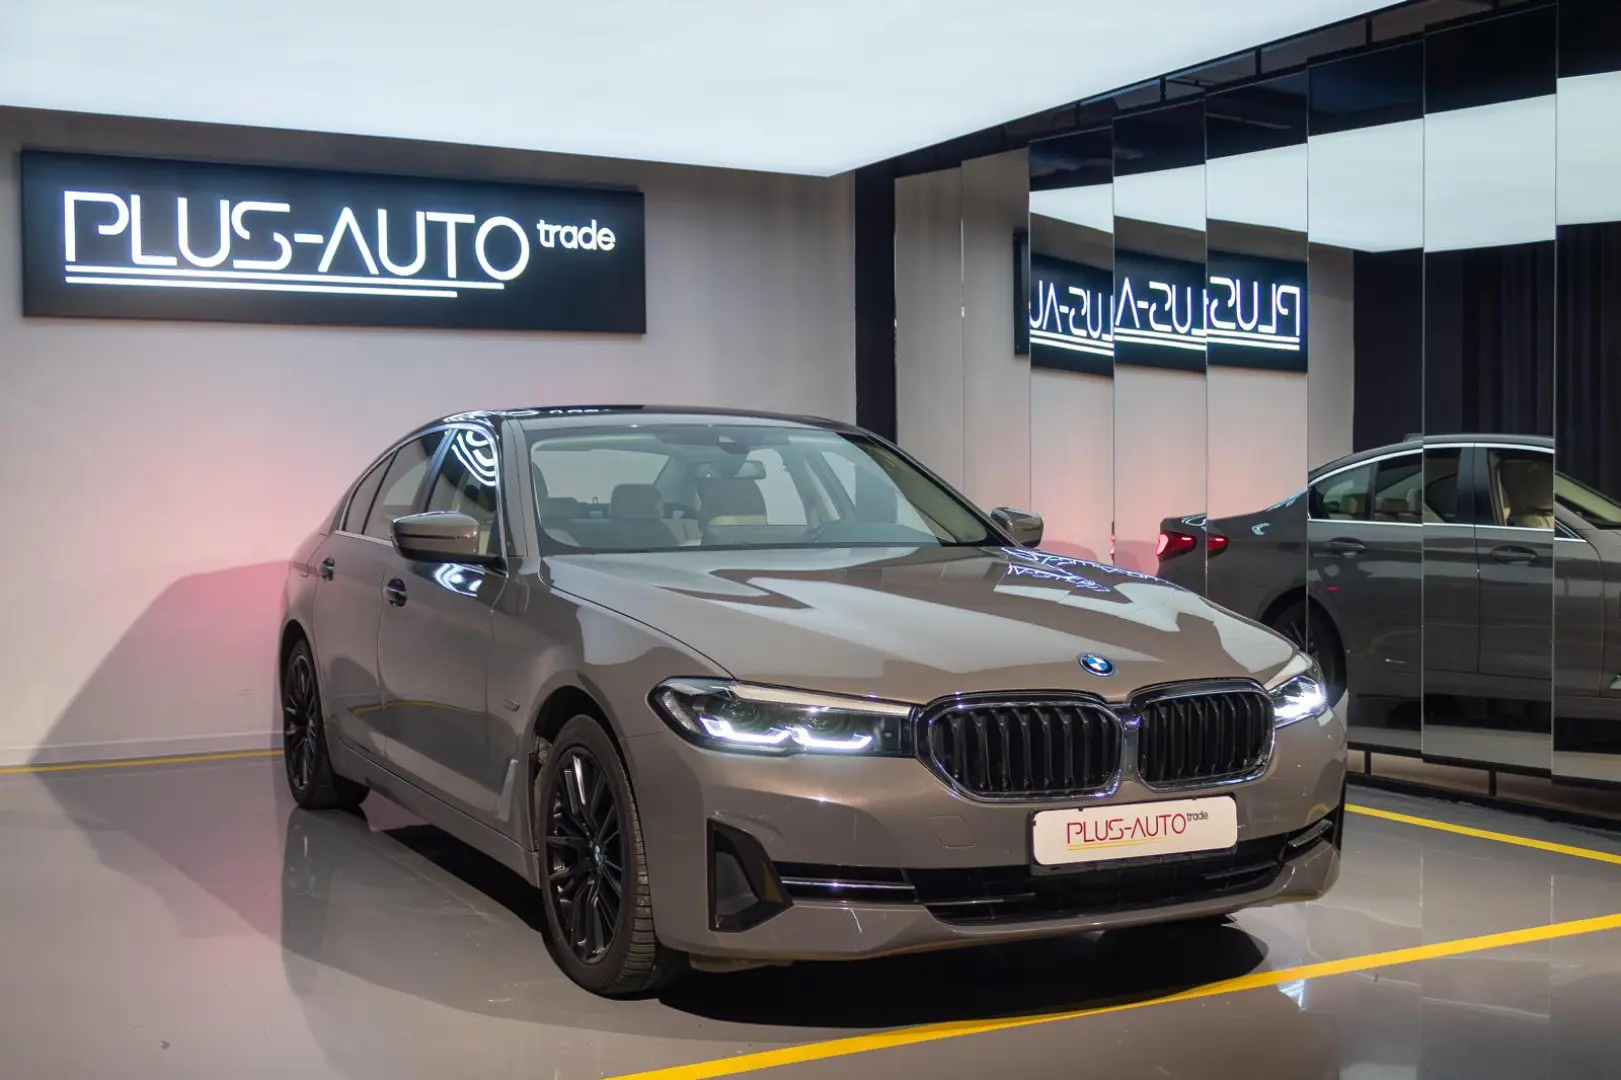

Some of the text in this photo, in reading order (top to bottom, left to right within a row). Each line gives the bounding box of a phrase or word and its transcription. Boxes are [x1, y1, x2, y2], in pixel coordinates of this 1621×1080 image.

[64, 190, 616, 281] PLUS-AUTO trade
[1066, 809, 1209, 844] PLUS-AUTO trade
